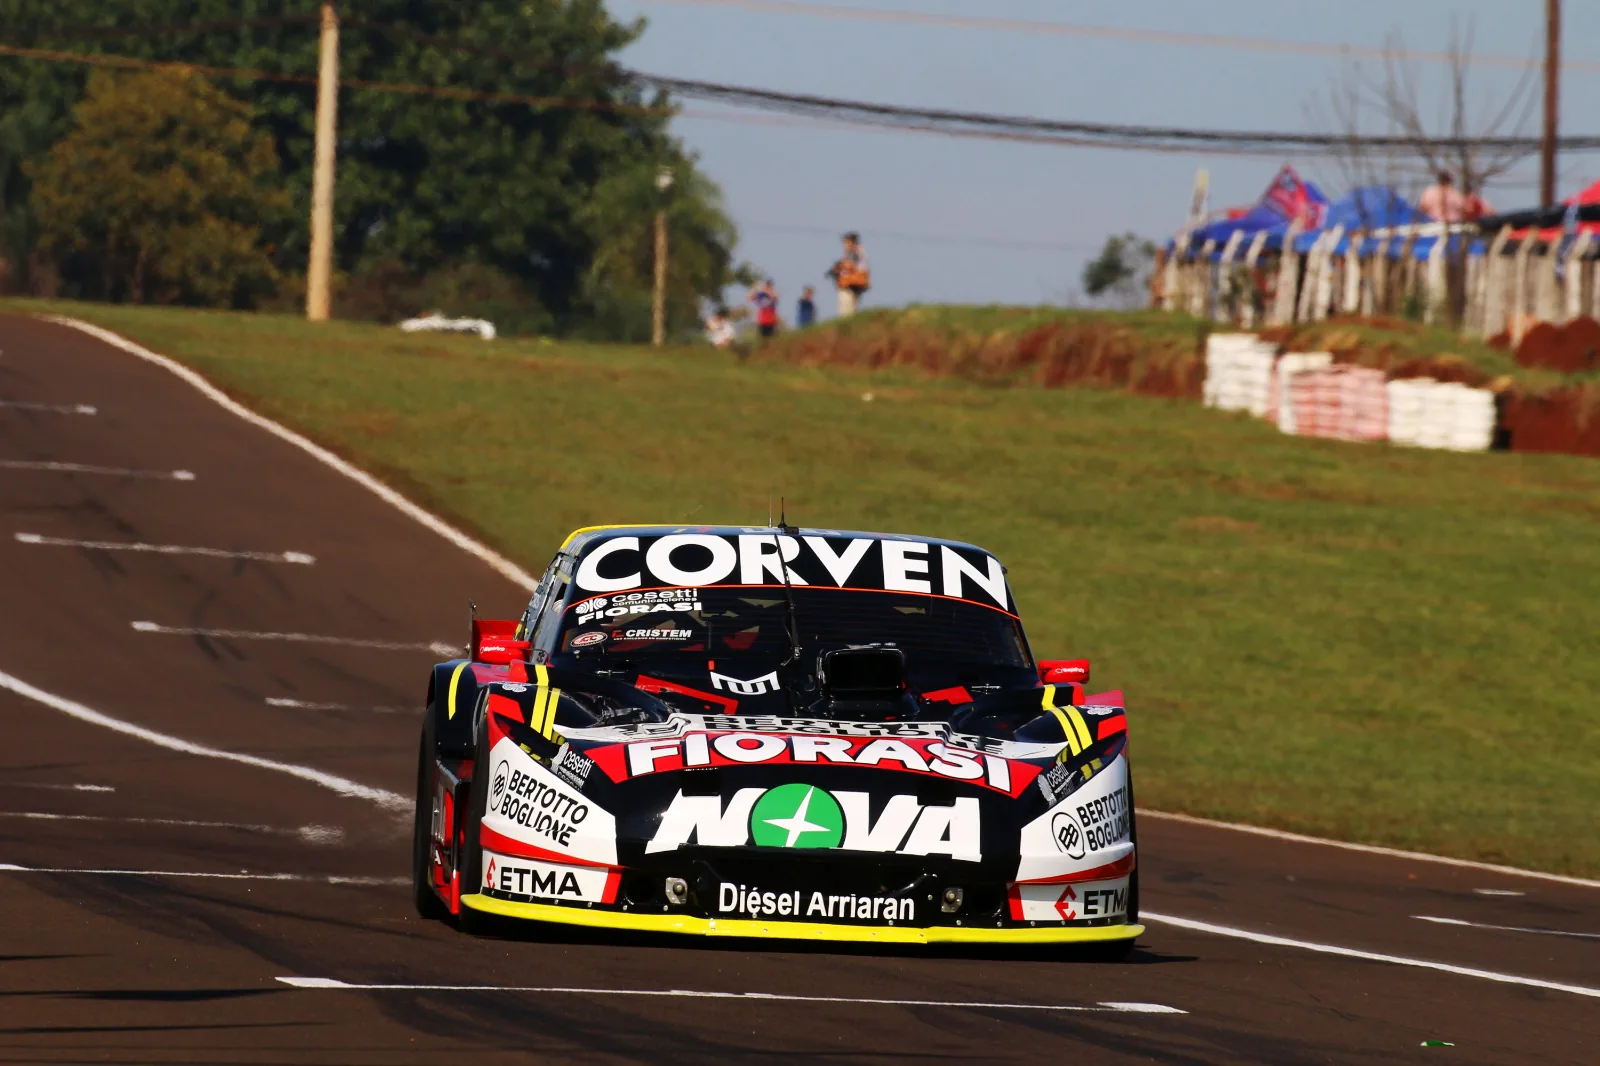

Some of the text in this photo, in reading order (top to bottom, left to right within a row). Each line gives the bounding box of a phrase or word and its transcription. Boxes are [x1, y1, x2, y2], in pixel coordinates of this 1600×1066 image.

[576, 534, 1009, 612] CORVEN
[611, 588, 698, 603] cesetti
[578, 602, 702, 625] FIORASI
[625, 629, 692, 638] CRISTEM
[628, 732, 1011, 793] FIORASI
[509, 769, 588, 825] BERTOTTO
[501, 794, 577, 848] BOGLIONE
[645, 783, 982, 862] NOVA
[500, 866, 582, 897] ETMA
[719, 882, 915, 920] Diésel Arriaran
